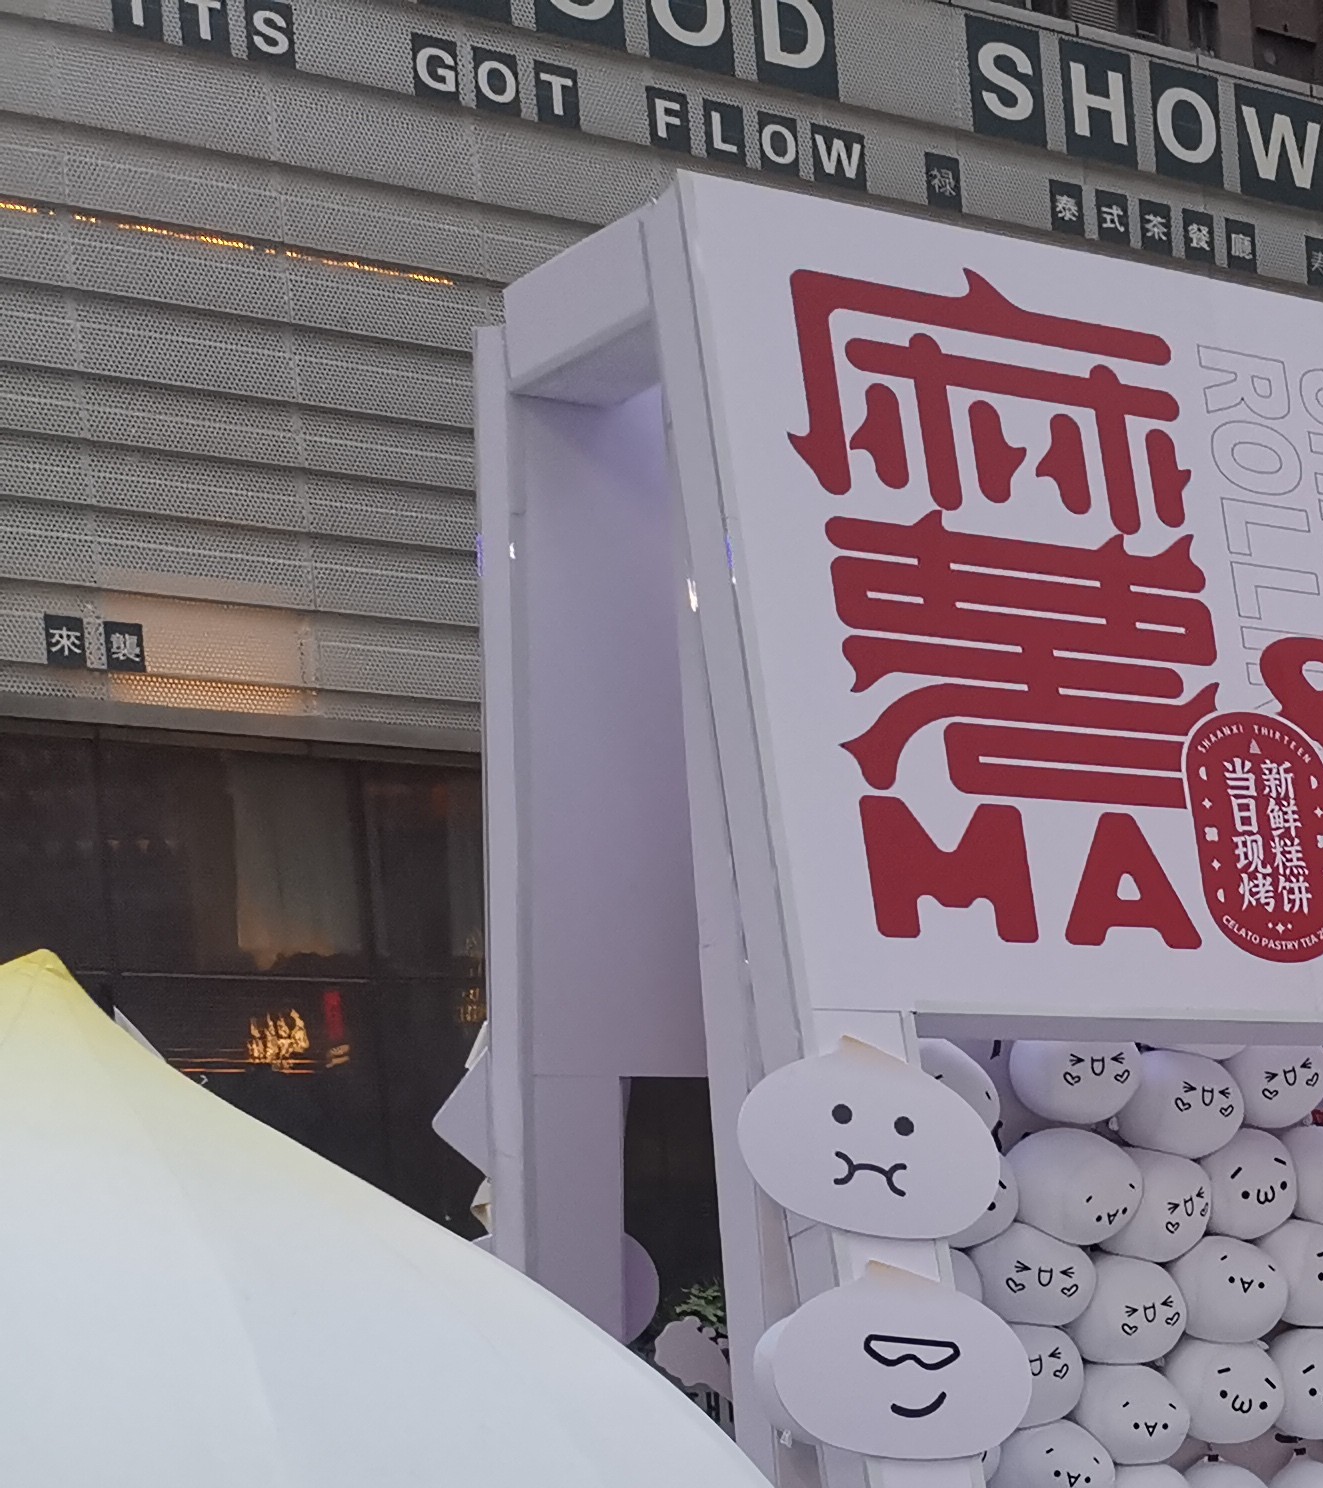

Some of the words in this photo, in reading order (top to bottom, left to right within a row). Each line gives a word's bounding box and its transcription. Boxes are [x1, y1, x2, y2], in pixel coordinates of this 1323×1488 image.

[131, 0, 289, 54] ITS
[416, 47, 573, 116] GOT
[654, 98, 862, 179] FLOW
[548, 0, 826, 69] OD
[976, 42, 1321, 190] SHOW
[1054, 194, 1252, 260] 泰式茶餐廳
[1253, 725, 1312, 764] THIRTEEN
[1222, 757, 1276, 912] 当日现烤
[1261, 759, 1312, 915] 新鲜糕饼
[1299, 936, 1319, 949] TEA
